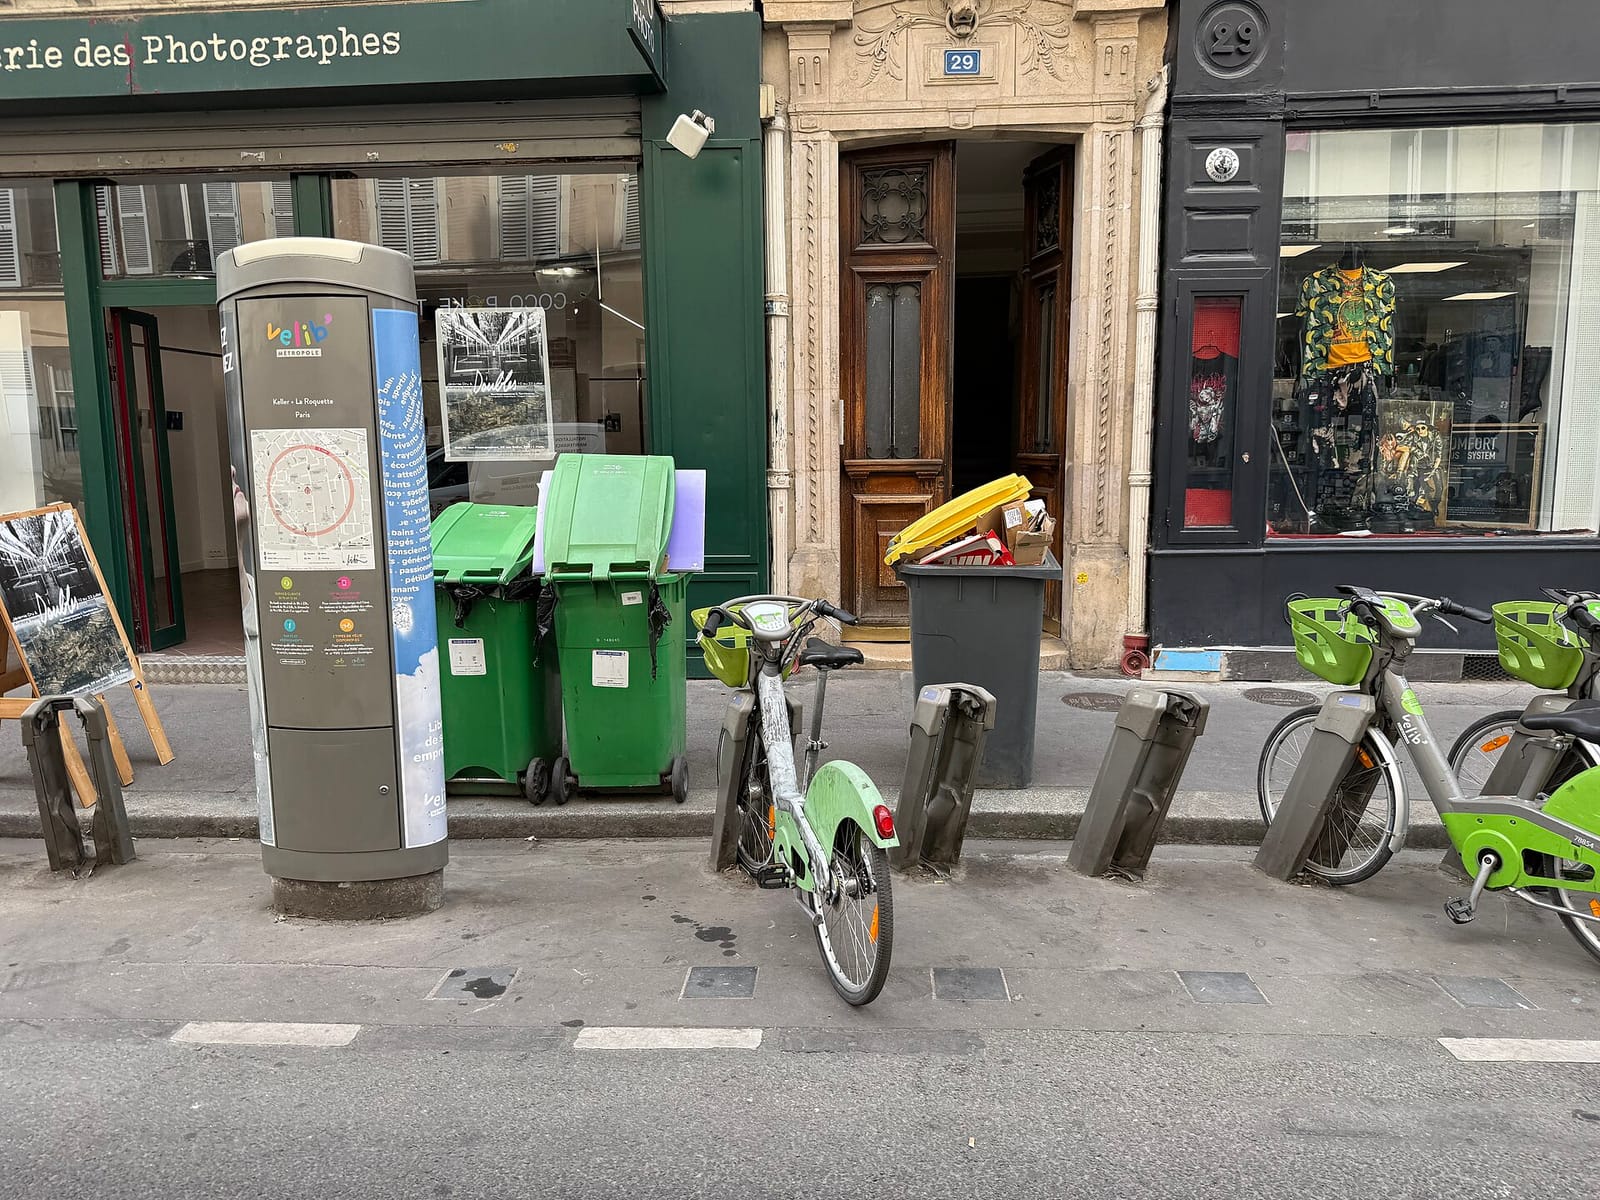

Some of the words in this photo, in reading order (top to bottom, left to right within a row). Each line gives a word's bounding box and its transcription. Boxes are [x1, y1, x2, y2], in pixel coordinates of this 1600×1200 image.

[1211, 21, 1258, 55] 29
[0, 39, 63, 71] rie
[73, 37, 130, 68] des
[141, 27, 400, 67] Photographes
[951, 55, 974, 70] 29
[304, 397, 334, 407] Roquette
[1467, 451, 1496, 460] SYSTEM
